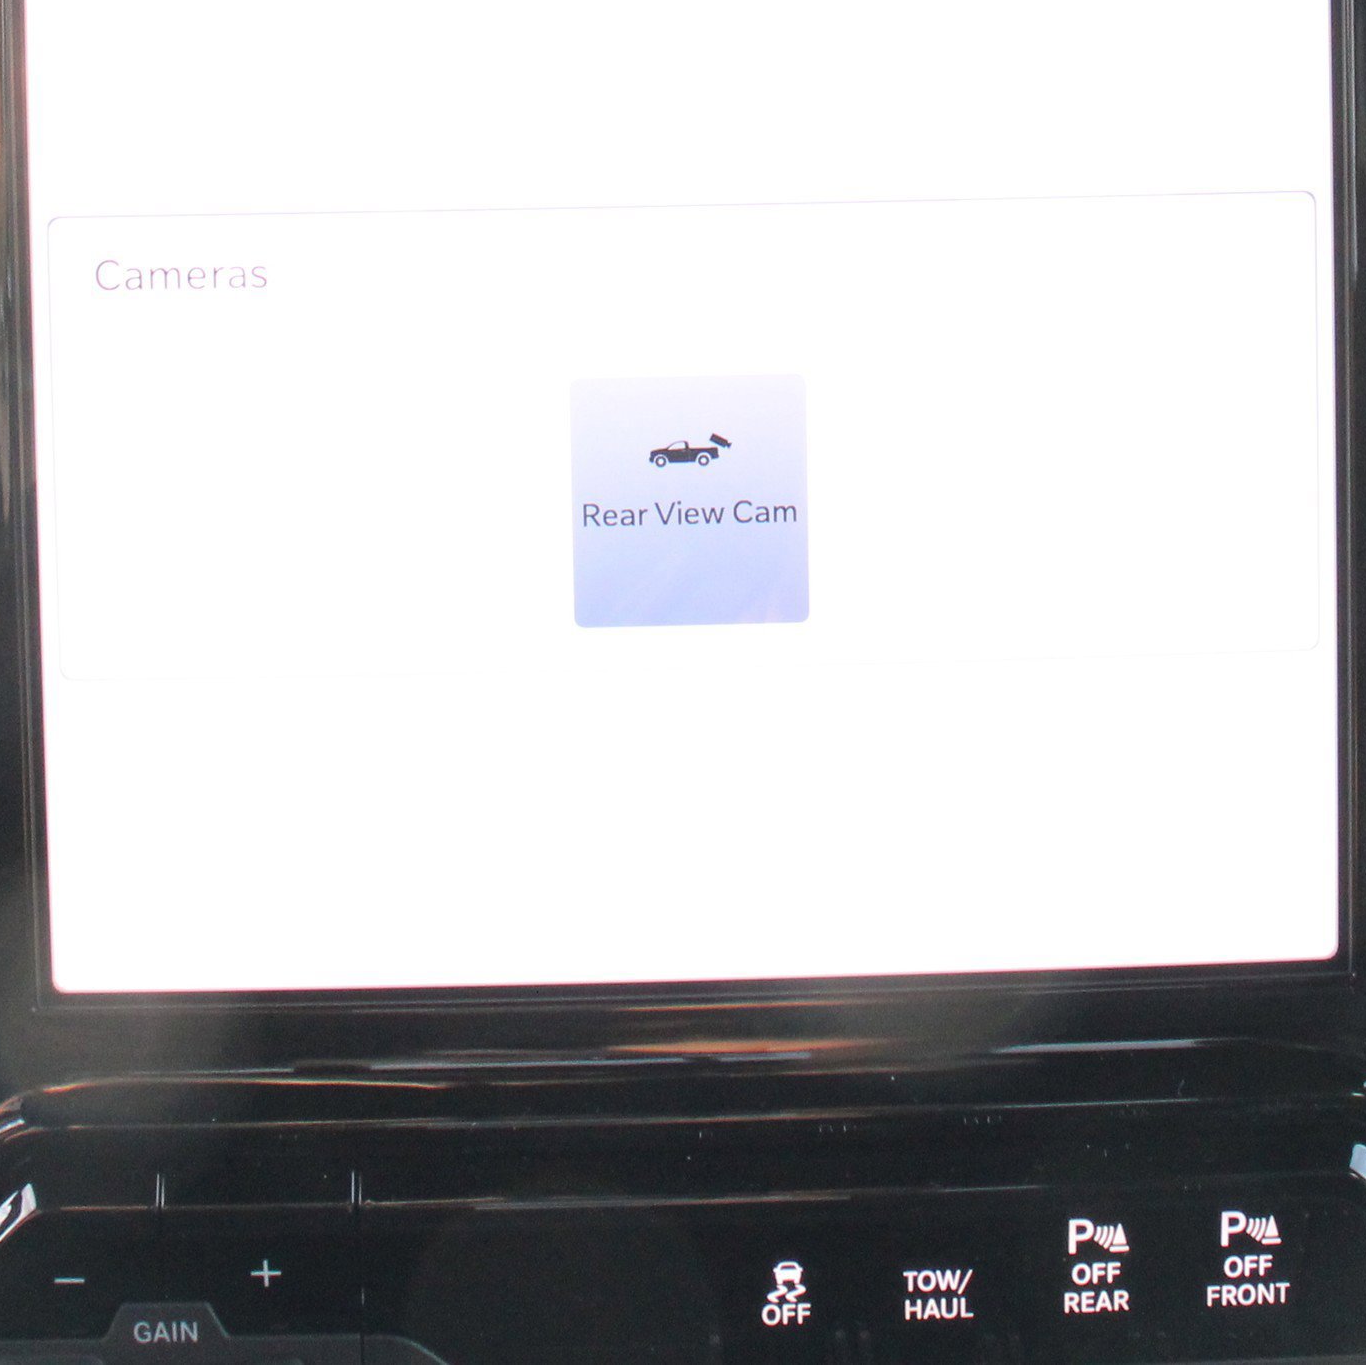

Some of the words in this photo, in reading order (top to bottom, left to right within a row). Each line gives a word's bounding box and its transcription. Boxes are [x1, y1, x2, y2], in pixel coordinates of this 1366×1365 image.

[95, 259, 268, 291] Cameras
[582, 503, 648, 527] Rear
[654, 500, 725, 525] View
[733, 499, 798, 523] Cam
[1071, 1261, 1122, 1286] OFF
[1223, 1253, 1274, 1279] OFF
[902, 1268, 974, 1295] TOW/
[1063, 1289, 1131, 1314] REAR
[1206, 1281, 1291, 1308] FRONT
[761, 1302, 812, 1327] OFF
[904, 1296, 975, 1321] HAUL
[133, 1320, 199, 1343] GAIN
